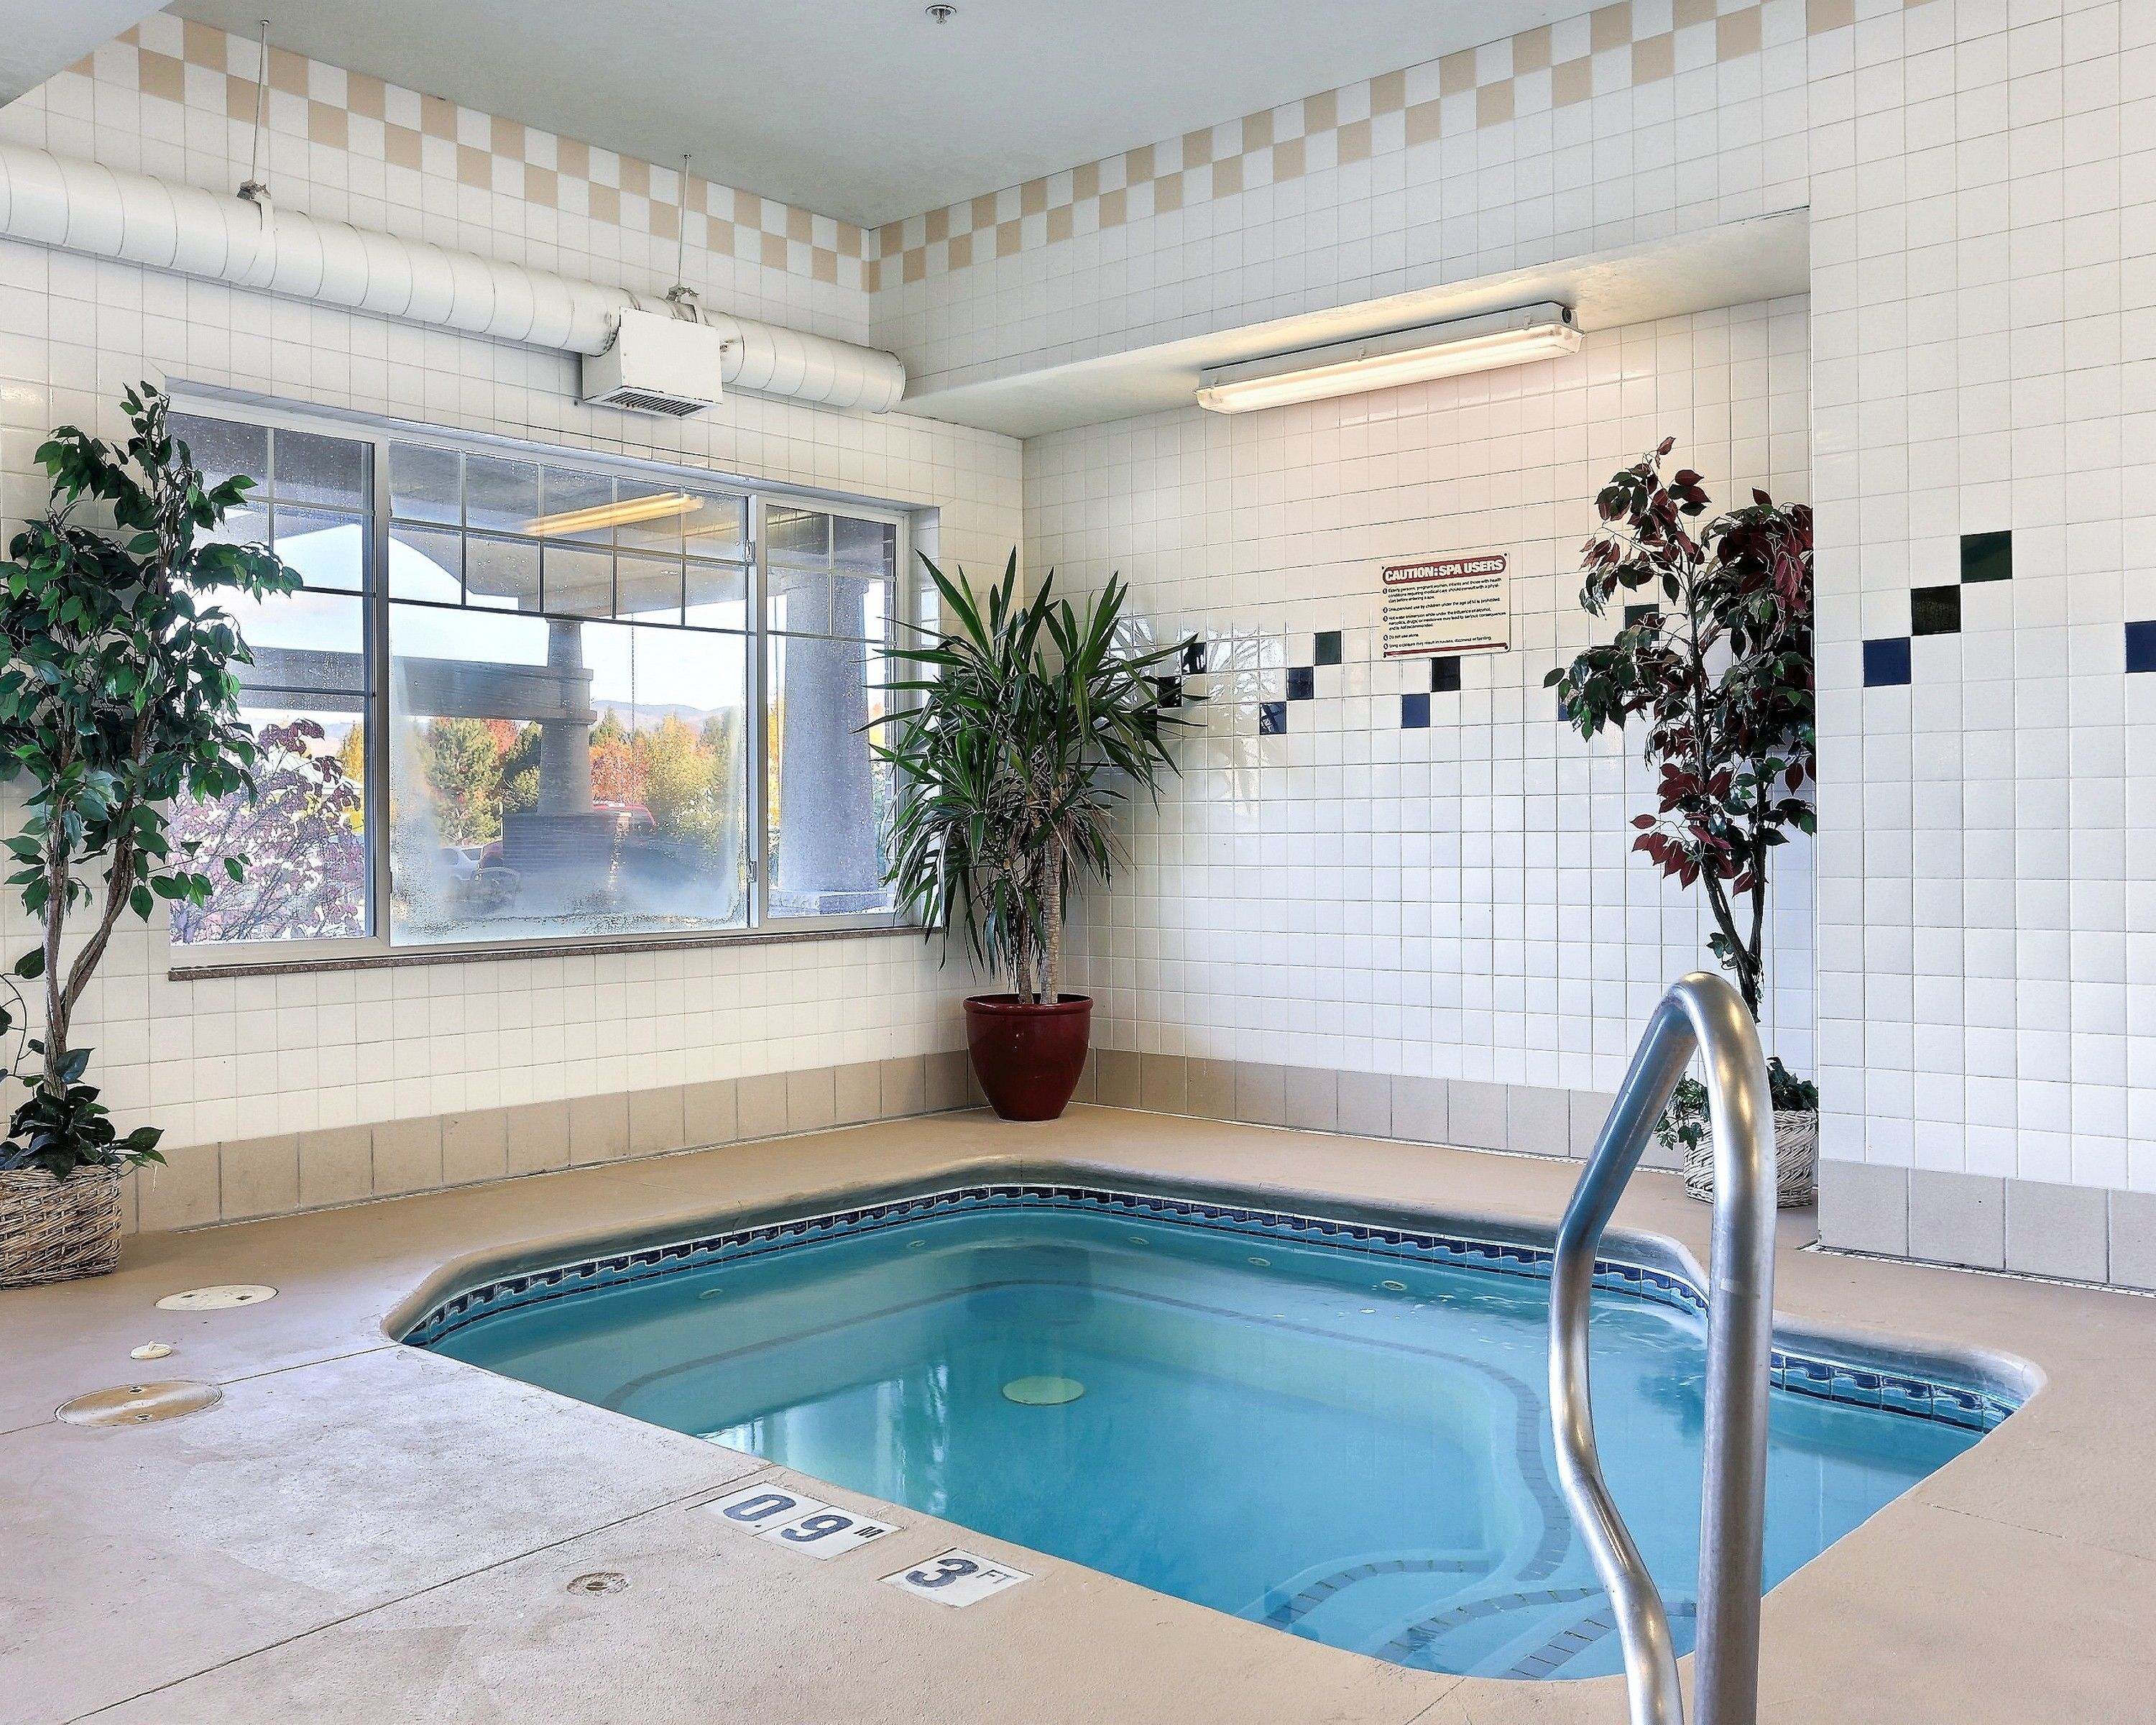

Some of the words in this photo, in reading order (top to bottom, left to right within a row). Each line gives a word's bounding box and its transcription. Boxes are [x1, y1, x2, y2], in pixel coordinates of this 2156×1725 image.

[1386, 566, 1438, 581] CAUTION:
[1439, 564, 1462, 576] SPA
[1464, 559, 1503, 573] USERS
[722, 1494, 854, 1542] 0.9
[853, 1525, 885, 1540] M
[905, 1558, 980, 1588] 3
[975, 1568, 1018, 1585] FT
